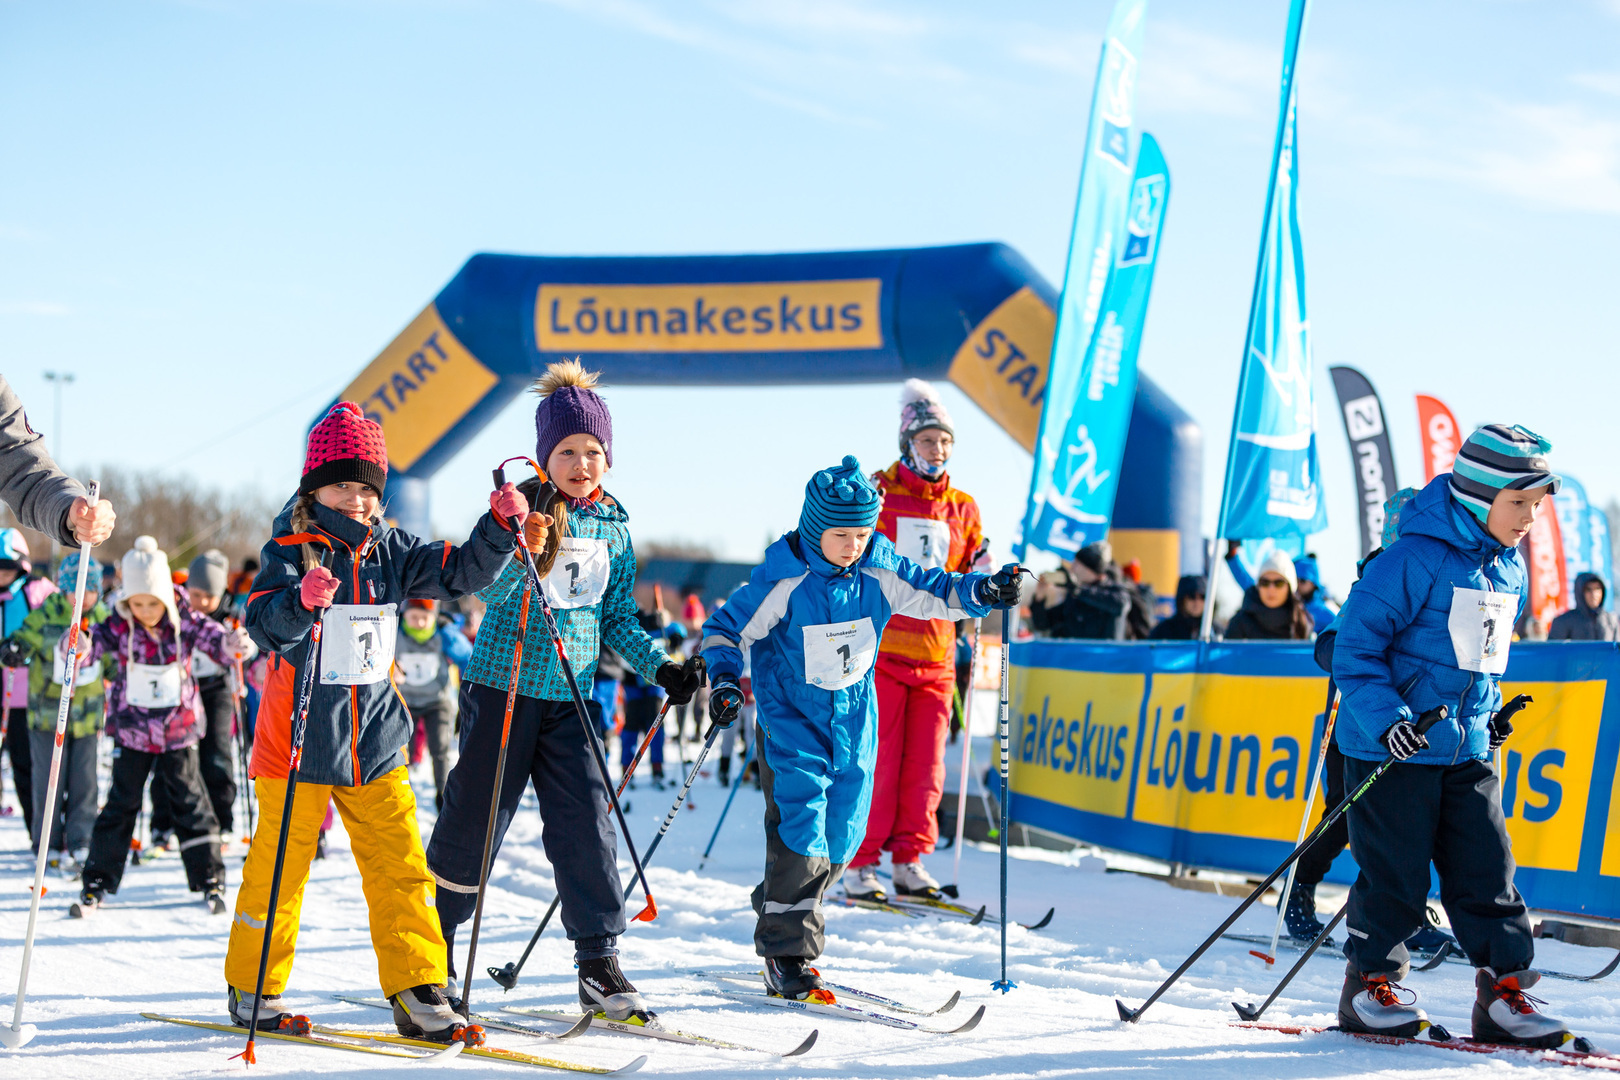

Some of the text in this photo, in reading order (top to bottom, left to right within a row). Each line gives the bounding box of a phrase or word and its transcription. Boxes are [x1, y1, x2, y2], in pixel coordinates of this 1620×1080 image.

[551, 296, 864, 334] Lõunakeskus
[975, 328, 1045, 406] STA
[565, 562, 579, 594] 1
[359, 632, 373, 668] 1
[1483, 619, 1496, 654] 1
[836, 644, 851, 674] 1
